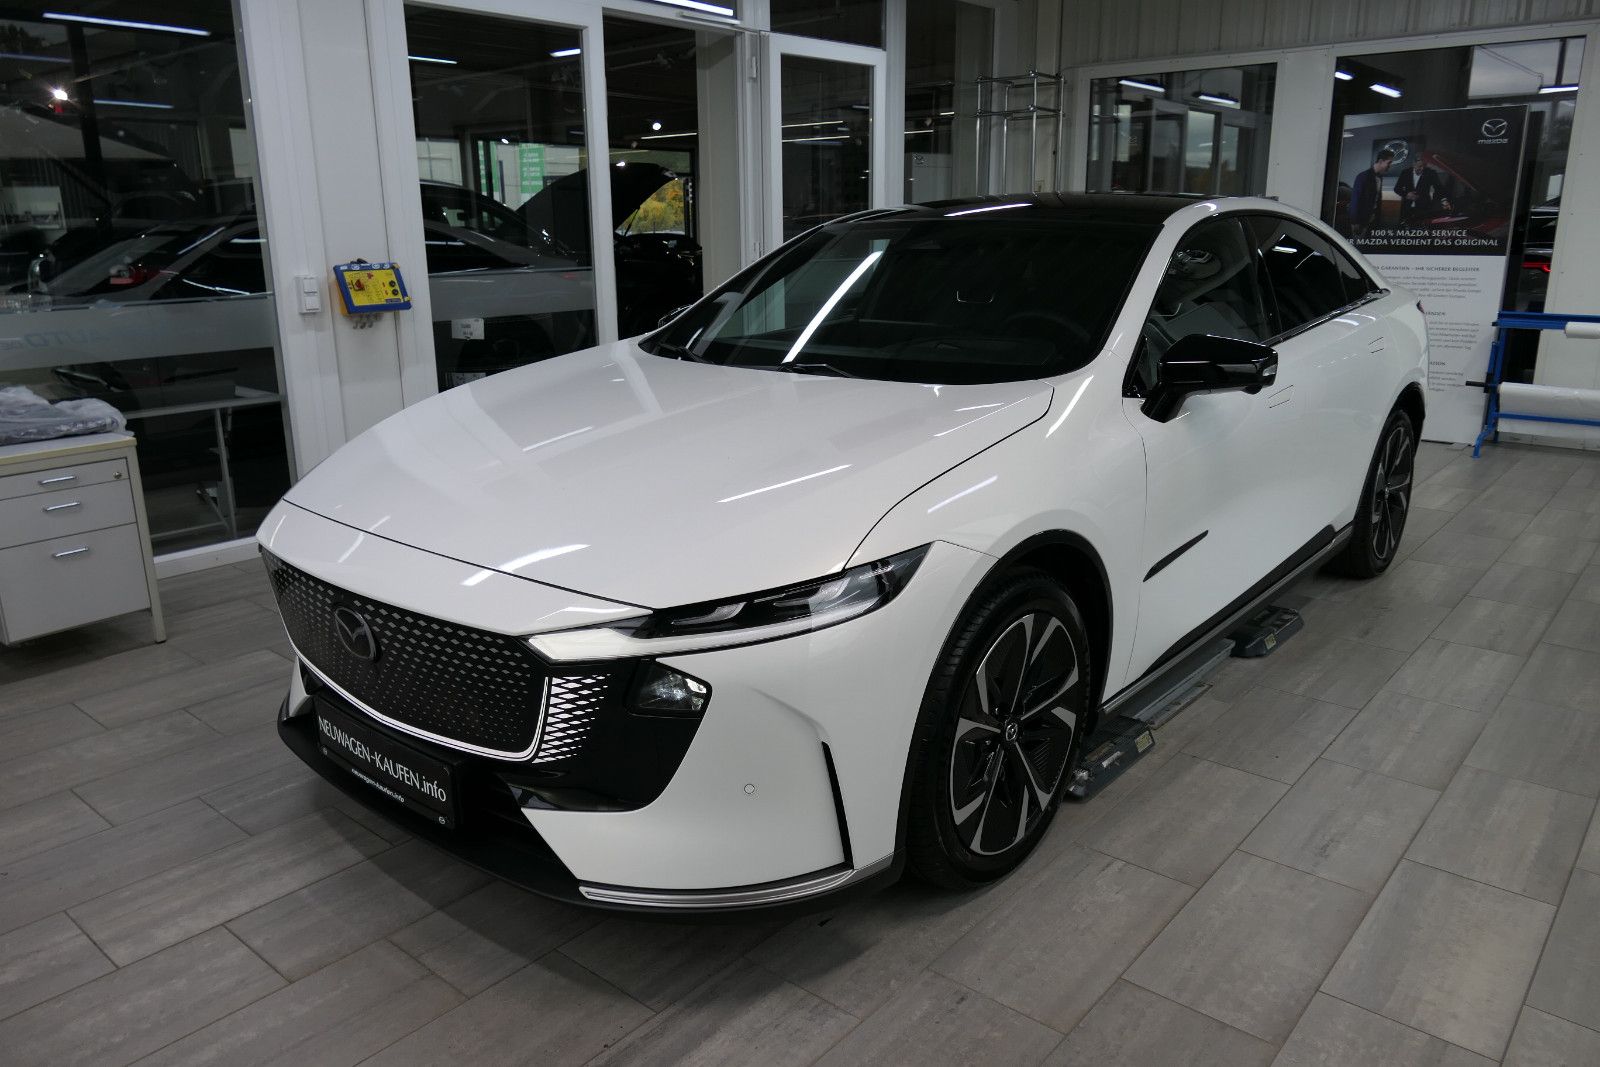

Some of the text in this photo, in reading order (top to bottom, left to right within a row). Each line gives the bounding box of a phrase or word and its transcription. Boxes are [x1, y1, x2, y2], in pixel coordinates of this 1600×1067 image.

[1432, 229, 1467, 237] SERVICE
[1390, 238, 1431, 246] VERDIENT
[1434, 238, 1452, 246] DAS
[1454, 238, 1498, 246] ORIGINAL
[318, 715, 447, 802] NEUWAGEN-KAUFEN.info
